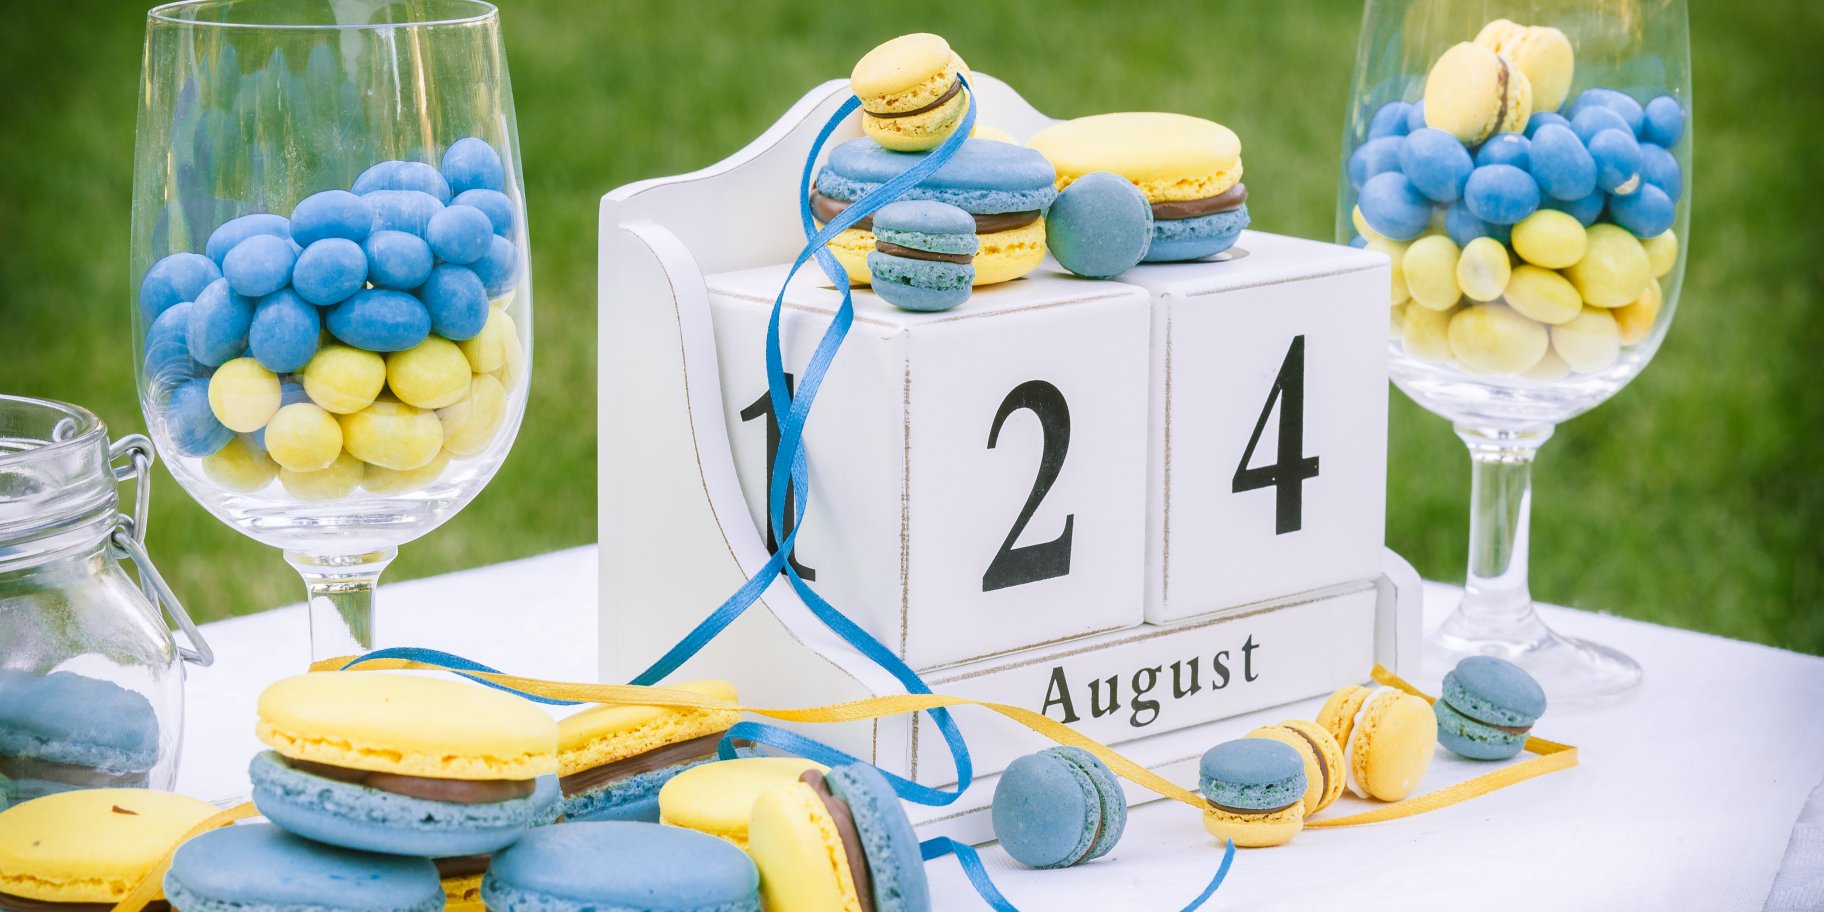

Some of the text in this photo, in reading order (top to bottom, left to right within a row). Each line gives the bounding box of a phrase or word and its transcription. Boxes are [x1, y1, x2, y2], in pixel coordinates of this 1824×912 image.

[982, 334, 1320, 592] 2 4
[1041, 634, 1261, 728] August
